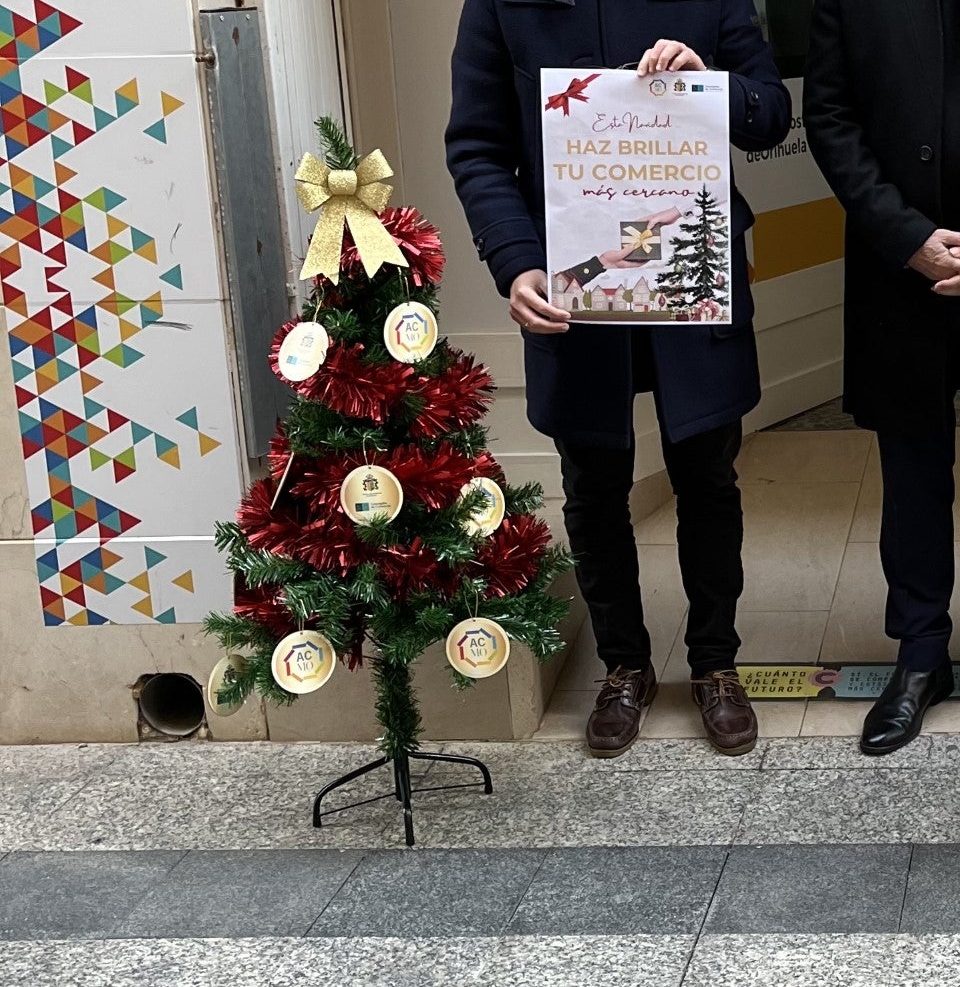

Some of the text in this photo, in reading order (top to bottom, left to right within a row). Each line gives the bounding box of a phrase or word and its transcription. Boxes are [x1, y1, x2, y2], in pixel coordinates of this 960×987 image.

[592, 112, 622, 133] Esta
[567, 139, 708, 156] HAZ BRILLAR
[553, 164, 721, 181] TU COMERCIO
[582, 185, 695, 200] más cercano
[405, 321, 418, 332] AC
[469, 637, 485, 648] AC
[295, 651, 312, 662] AC
[746, 669, 807, 679] ¿CUÁNTO
[743, 685, 803, 693] FUTURO?
